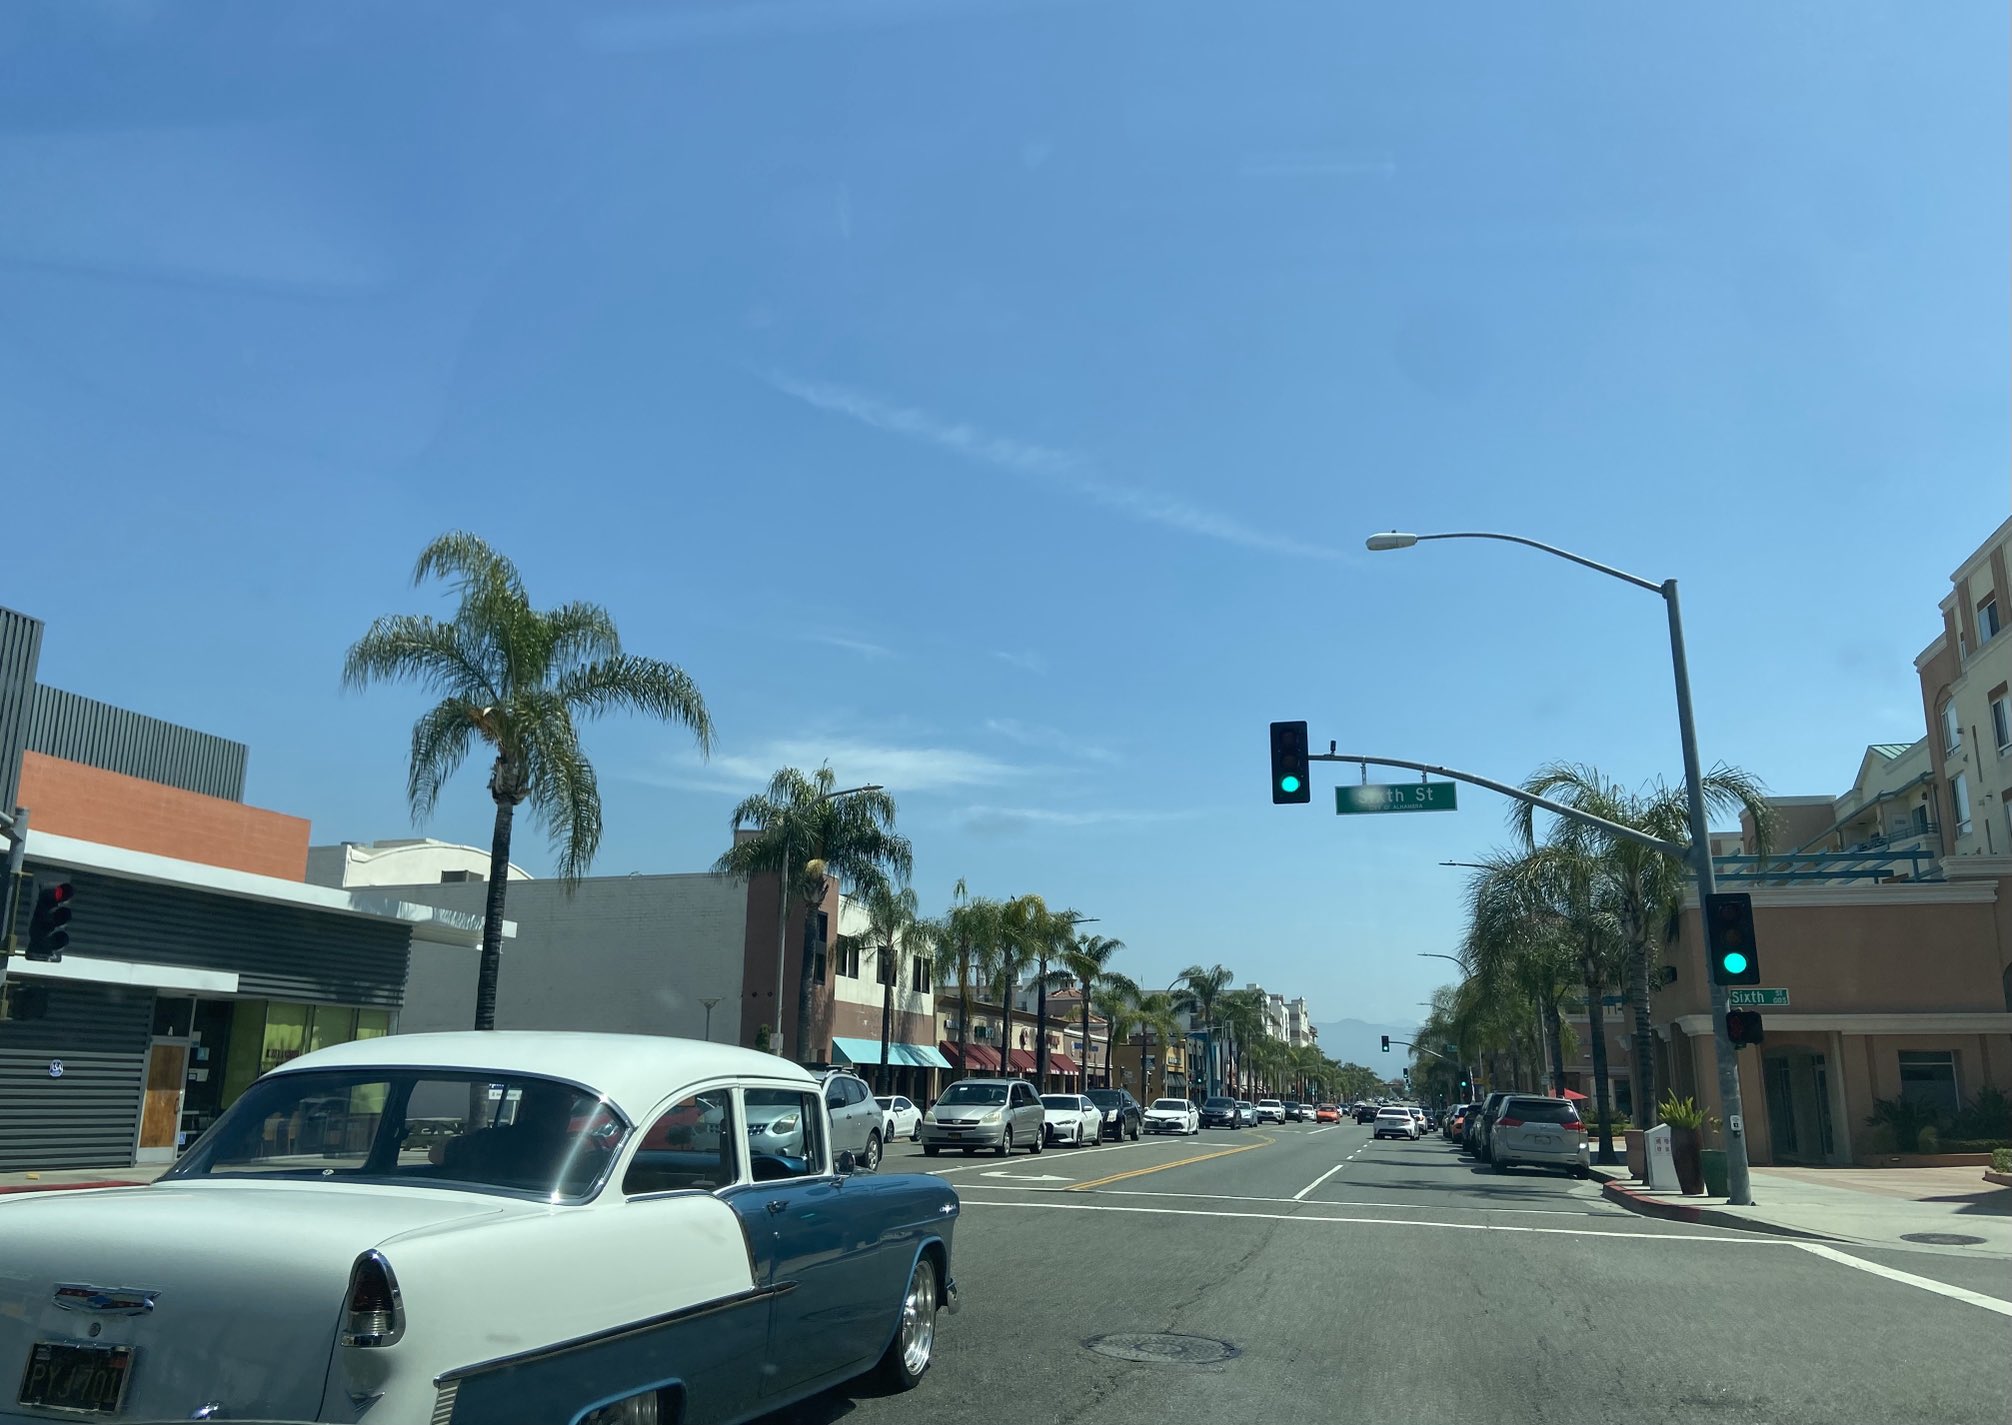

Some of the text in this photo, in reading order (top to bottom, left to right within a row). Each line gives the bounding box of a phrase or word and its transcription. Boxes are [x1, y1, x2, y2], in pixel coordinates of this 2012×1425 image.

[1358, 787, 1433, 803] Sxth St
[1732, 991, 1764, 1004] Sixth
